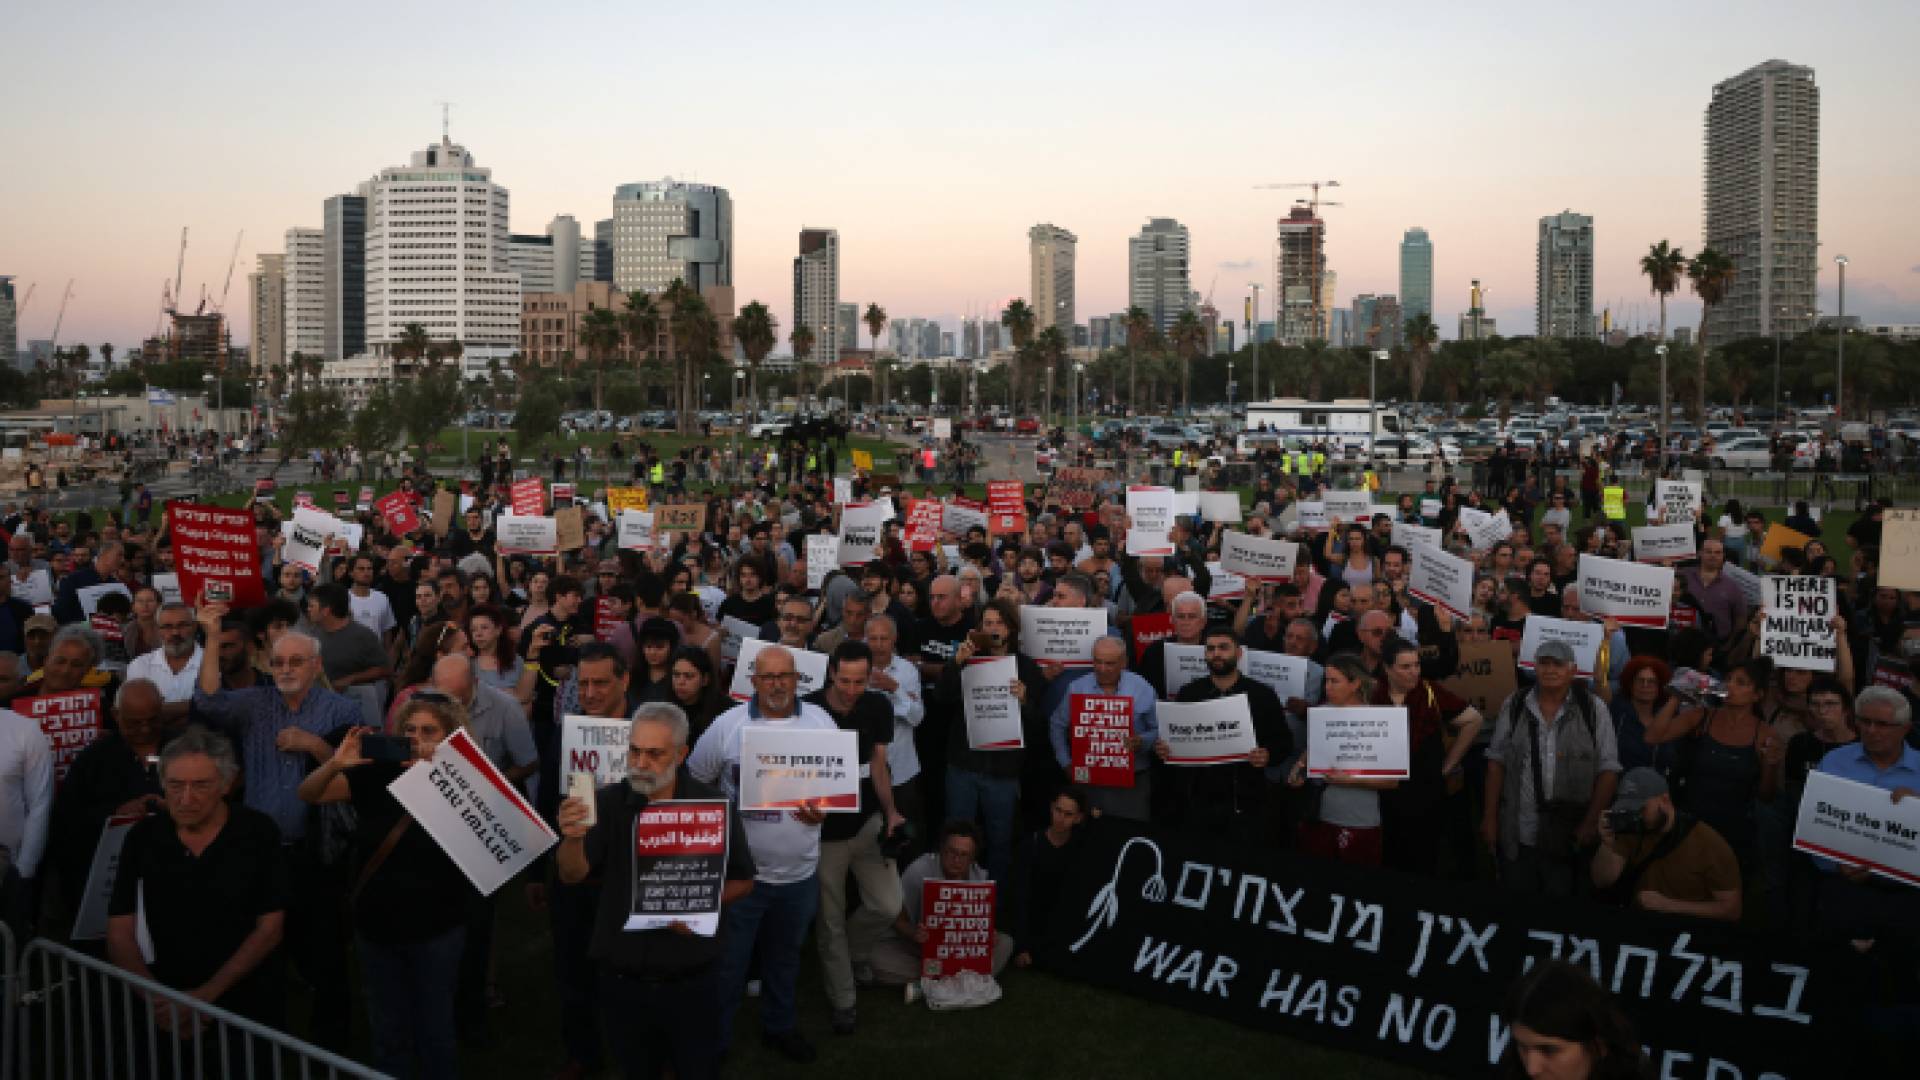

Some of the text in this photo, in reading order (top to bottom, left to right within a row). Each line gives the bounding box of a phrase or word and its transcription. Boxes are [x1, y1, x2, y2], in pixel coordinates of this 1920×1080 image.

[1771, 577, 1829, 594] THERE
[1775, 594, 1829, 616] IS NO
[31, 694, 95, 714] יהודים
[1085, 698, 1130, 711] יהודים
[1079, 712, 1130, 727] וערבים
[569, 747, 600, 773] NO
[1816, 801, 1918, 840] Stop the War
[1171, 860, 1386, 954] מנצחים
[1405, 909, 1500, 978] אין
[1132, 935, 1241, 1000] WAR
[1258, 968, 1362, 1028] HAS
[1377, 992, 1458, 1052] NO
